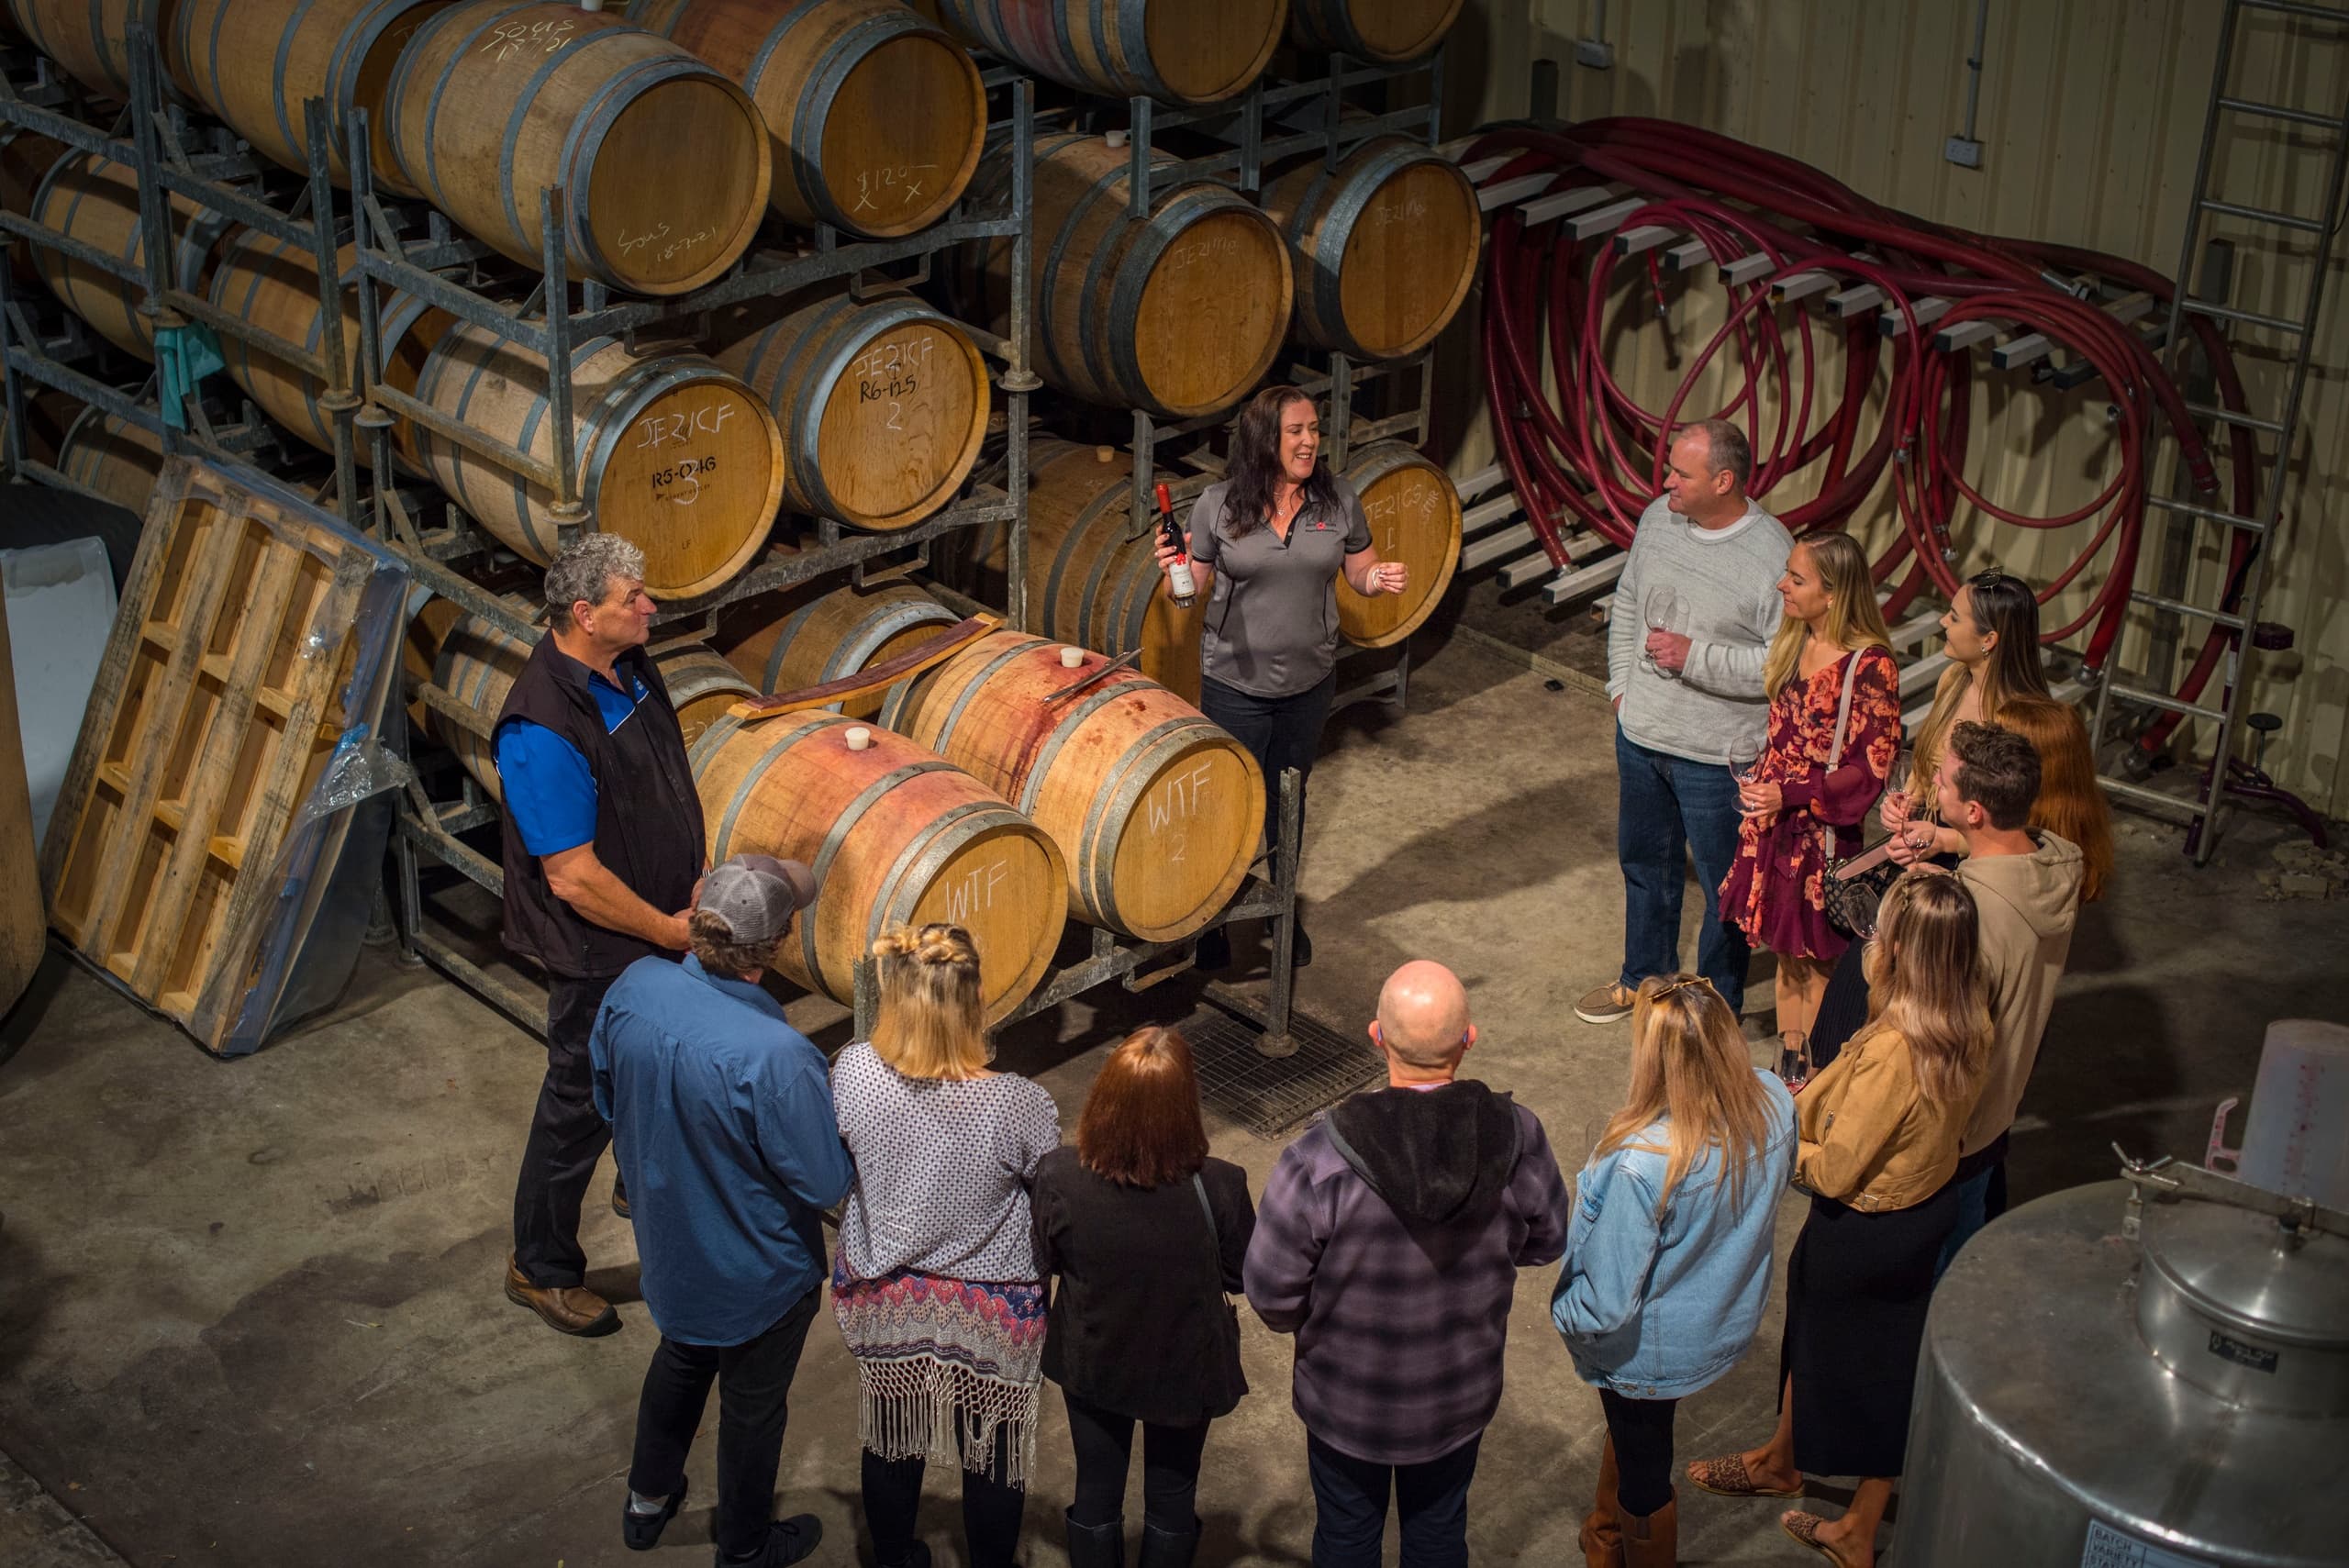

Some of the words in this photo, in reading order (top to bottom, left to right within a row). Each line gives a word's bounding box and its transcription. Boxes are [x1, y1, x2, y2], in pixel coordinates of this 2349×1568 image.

[885, 402, 903, 430] 2
[1148, 761, 1212, 836] WTF
[1171, 832, 1186, 862] 2
[945, 860, 1008, 925] WTF
[2092, 1540, 2138, 1567] VARIETY
[2095, 1528, 2132, 1551] BATCH
